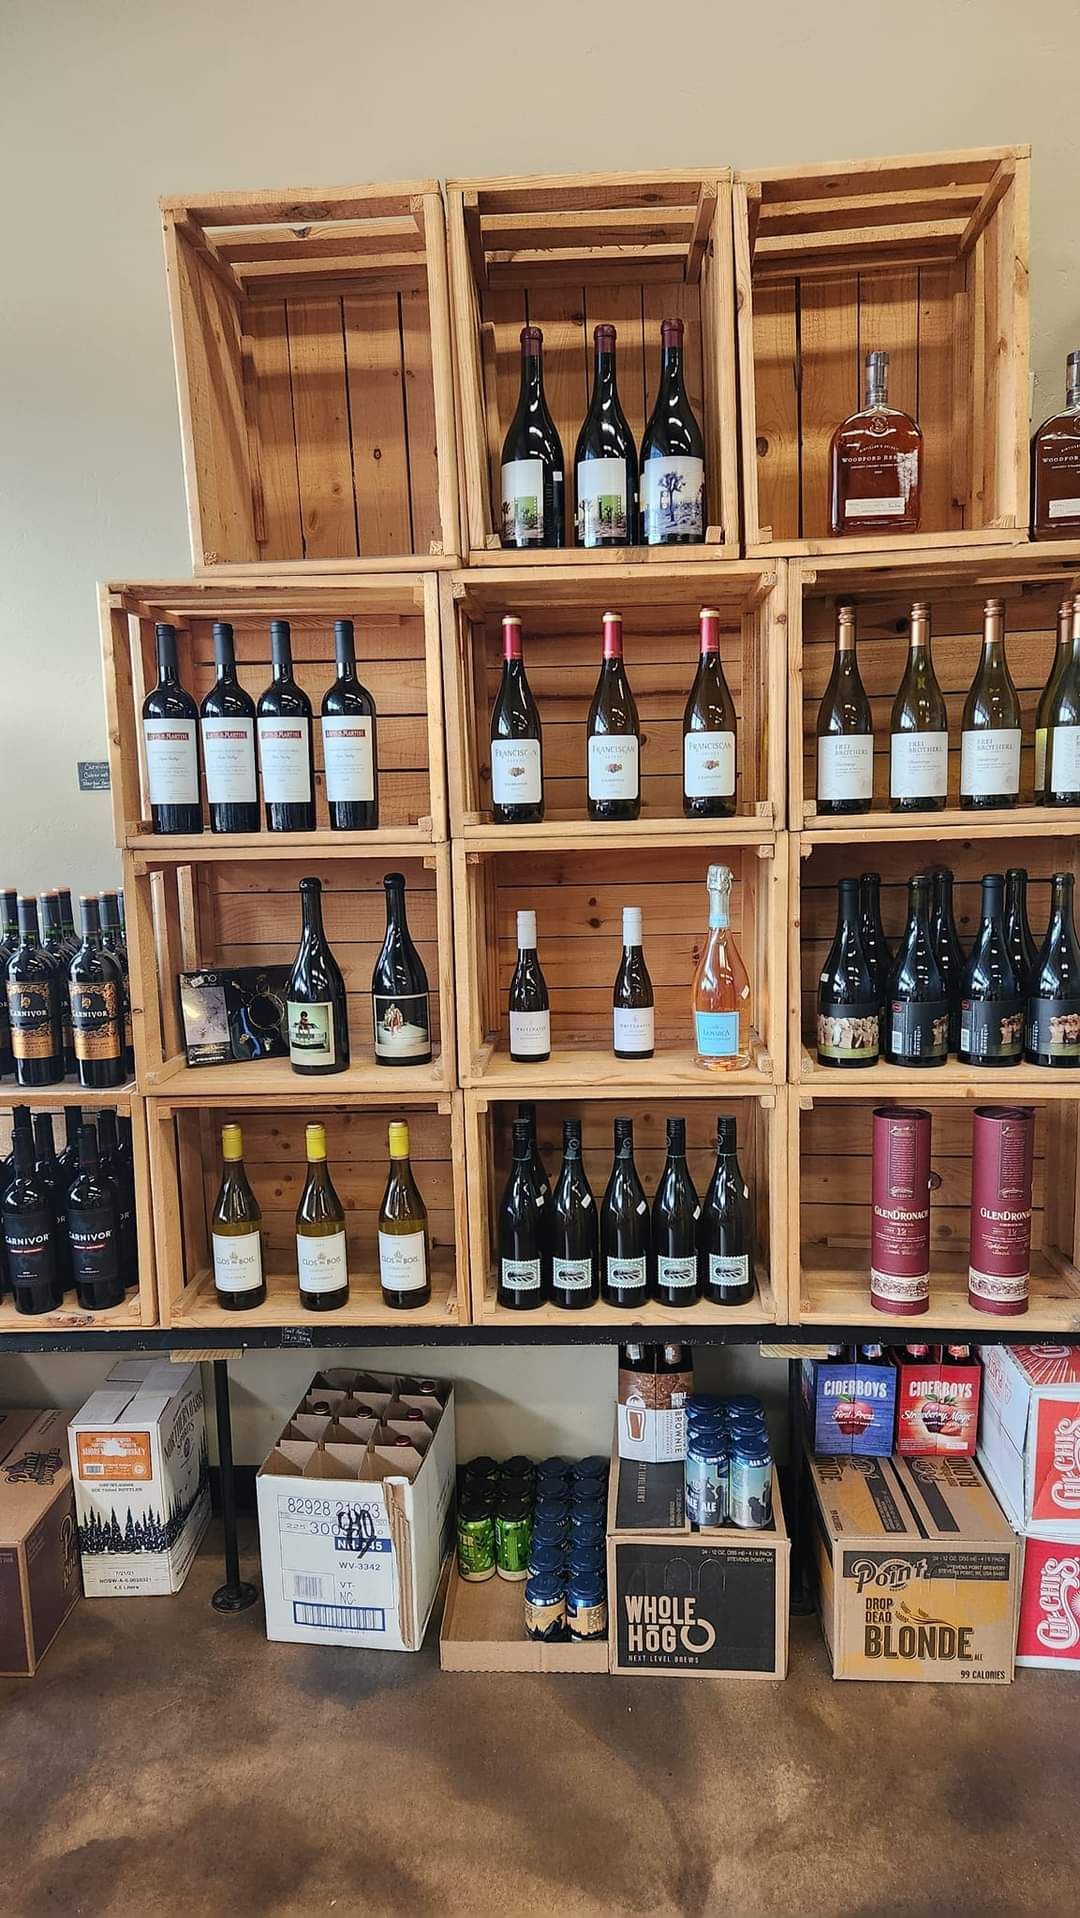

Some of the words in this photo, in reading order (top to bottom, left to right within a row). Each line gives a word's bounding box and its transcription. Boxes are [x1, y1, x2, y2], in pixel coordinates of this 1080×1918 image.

[841, 455, 882, 463] WOODFORD
[1042, 455, 1080, 463] WOODFOR
[592, 744, 635, 755] FRANCISCAN
[689, 742, 732, 752] FRANCISCAN
[4, 1232, 50, 1246] CARNIVOR
[68, 1229, 112, 1242] CARNIVOR
[824, 1380, 887, 1398] CIDERBOYS
[909, 1380, 972, 1398] CIDERBOYS
[674, 1410, 683, 1453] BROWNIE
[815, 1456, 842, 1482] ONDE
[944, 1456, 983, 1488] BLOND
[287, 1497, 331, 1516] 82928
[699, 1501, 717, 1513] ALE
[338, 1561, 381, 1572] WV-3342
[850, 1557, 932, 1594] Point
[624, 1595, 696, 1625] WHOLE
[865, 1597, 894, 1610] DROP
[865, 1610, 892, 1623] DEAD
[864, 1624, 975, 1662] BLONDE
[674, 1656, 699, 1664] BREWS
[960, 1670, 970, 1679] 99
[972, 1670, 1006, 1680] CALORIES
